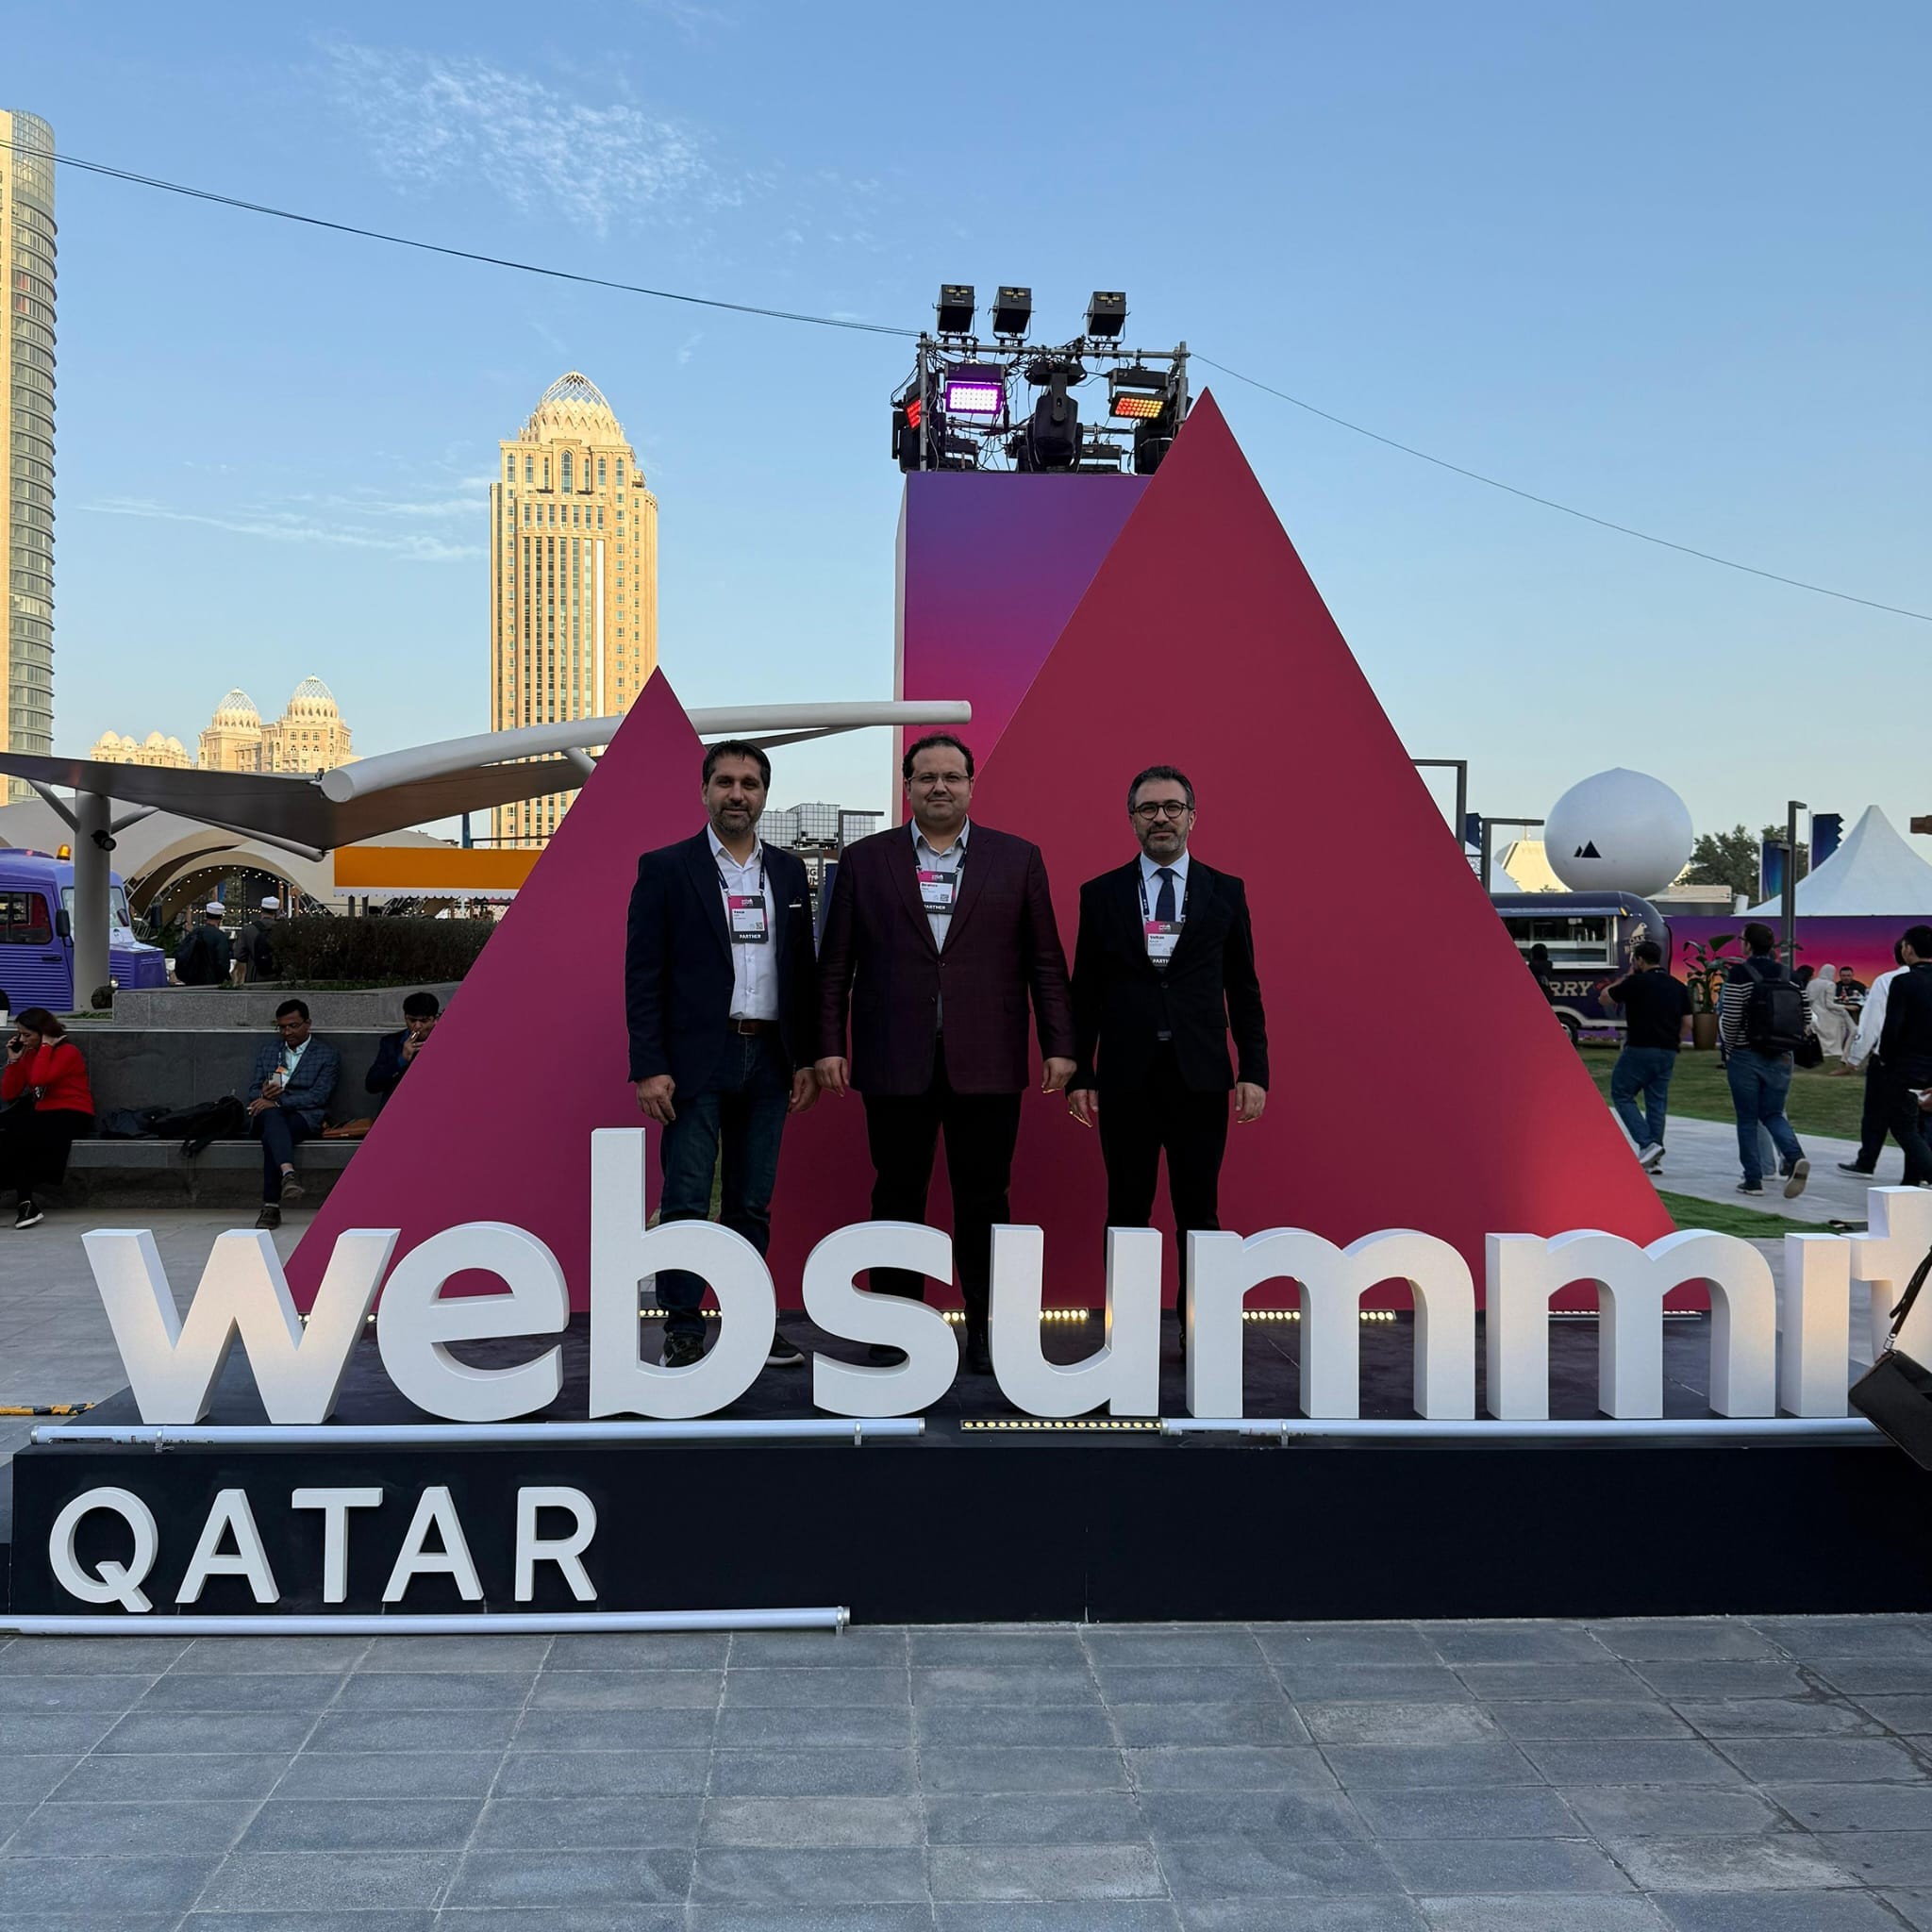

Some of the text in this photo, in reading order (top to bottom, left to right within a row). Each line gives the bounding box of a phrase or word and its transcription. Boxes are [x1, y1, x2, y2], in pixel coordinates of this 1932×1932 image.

[1629, 934, 1646, 944] OAK
[1548, 981, 1594, 997] RRY
[49, 1486, 598, 1613] QATAR
